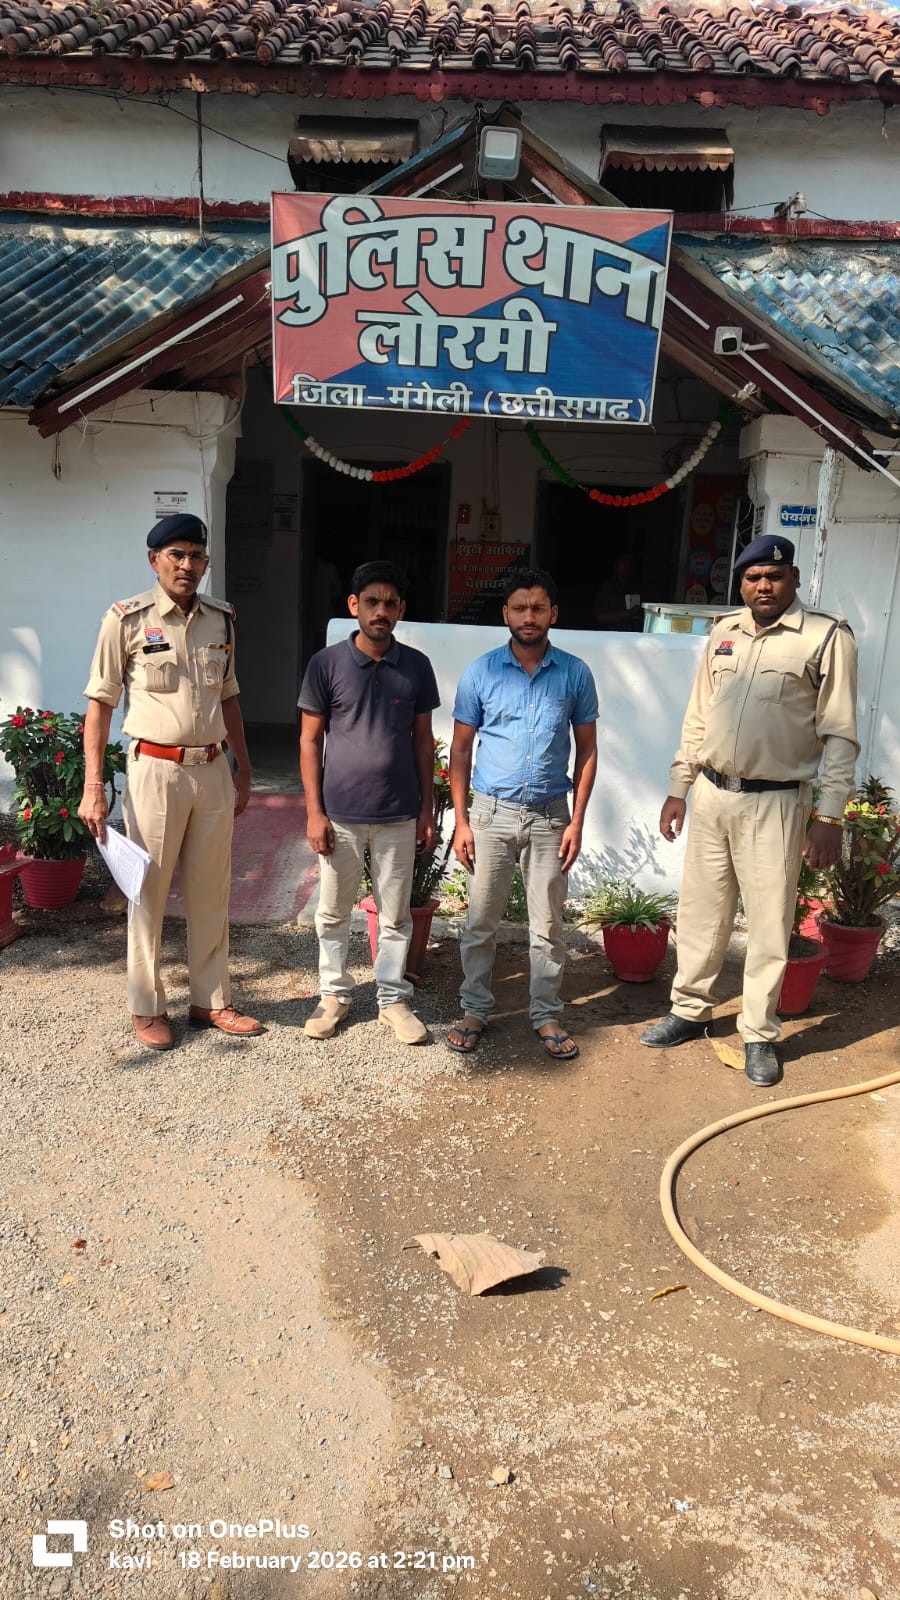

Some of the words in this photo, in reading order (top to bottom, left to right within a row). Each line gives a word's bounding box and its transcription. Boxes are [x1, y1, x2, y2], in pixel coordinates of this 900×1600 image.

[273, 196, 495, 327] पुलिस
[503, 215, 665, 331] थाना
[356, 290, 559, 374] लोरमी
